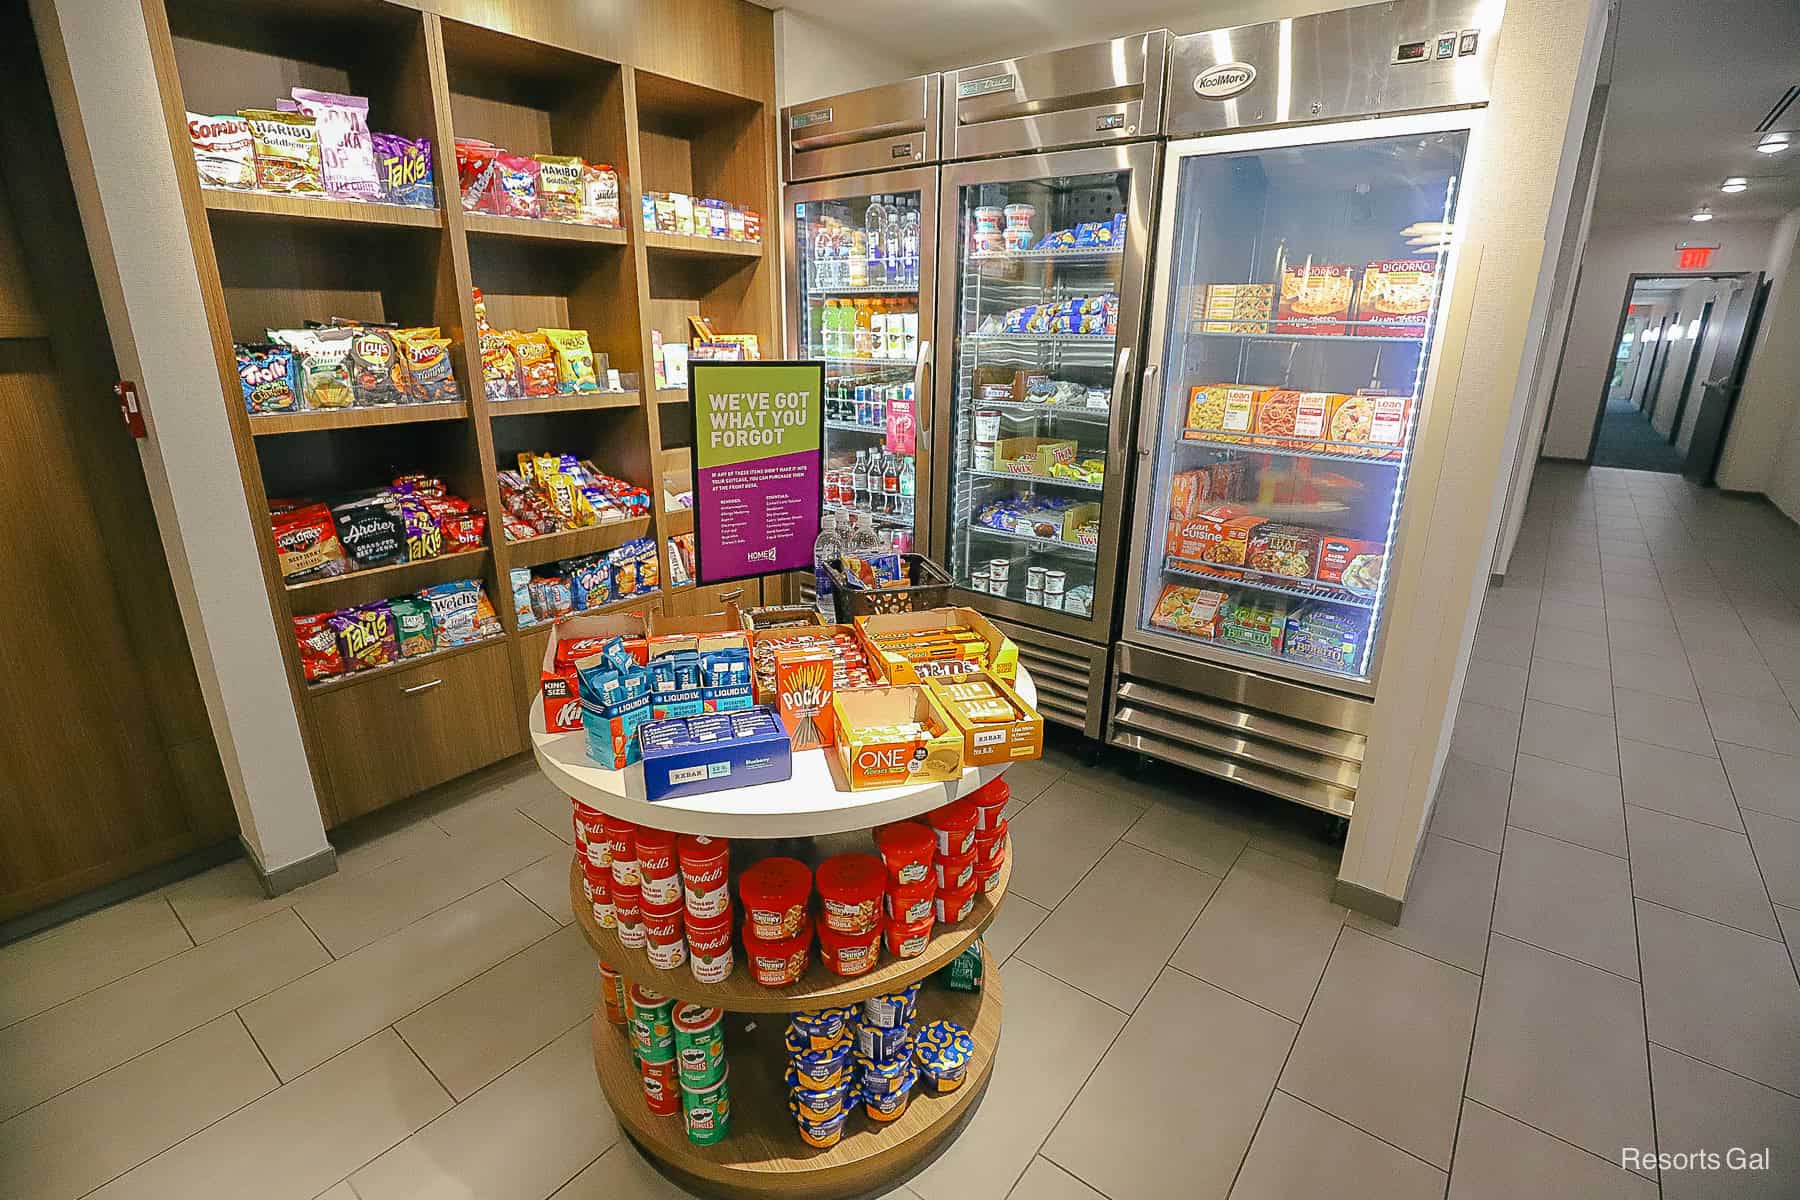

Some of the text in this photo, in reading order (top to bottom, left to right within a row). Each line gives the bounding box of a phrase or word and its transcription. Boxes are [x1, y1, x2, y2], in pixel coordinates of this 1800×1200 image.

[1199, 74, 1246, 89] KoolMore
[255, 121, 311, 140] HARIBO
[384, 154, 427, 193] Takis
[542, 165, 579, 179] HARIBO
[708, 391, 810, 411] WE'VE GOT
[709, 409, 807, 430] WHAT YOU
[710, 428, 785, 448] FORGOT
[343, 520, 396, 544] Archer
[1186, 521, 1210, 532] Lean
[407, 526, 442, 562] Takis
[458, 534, 481, 544] bits
[1077, 534, 1098, 545] Twi
[1269, 538, 1299, 549] THAI
[356, 543, 399, 558] BEEF JERKY
[434, 592, 478, 613] Welch's
[340, 613, 387, 658] Takis
[544, 682, 566, 690] KING
[547, 688, 567, 696] SIZE
[663, 693, 690, 703] LIQUID
[714, 689, 740, 698] LIQUID
[782, 687, 832, 711] POCKY
[618, 700, 640, 713] LIQUID
[745, 757, 770, 766] Blueberry
[858, 748, 906, 769] ONE
[753, 913, 780, 924] CHUNKY
[840, 950, 866, 959] CHUNKY
[758, 960, 784, 970] CHUNKY
[690, 1119, 714, 1130] PRINGLES
